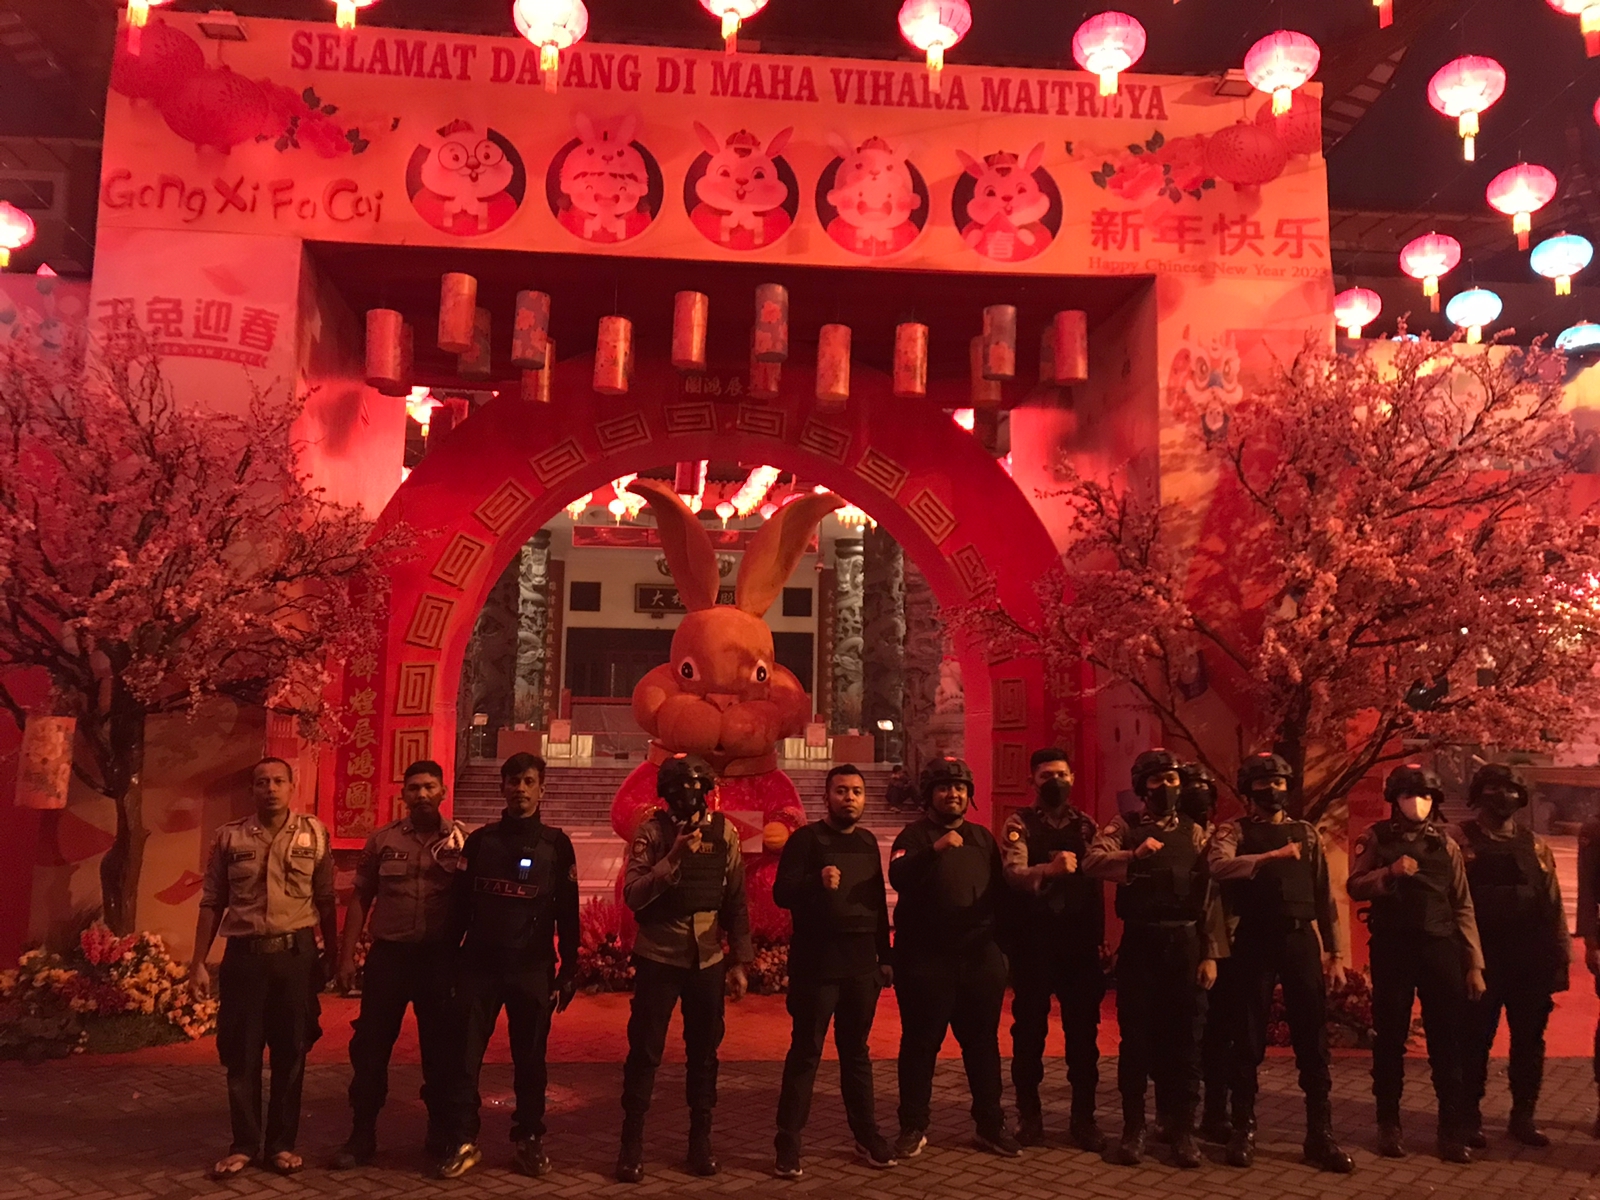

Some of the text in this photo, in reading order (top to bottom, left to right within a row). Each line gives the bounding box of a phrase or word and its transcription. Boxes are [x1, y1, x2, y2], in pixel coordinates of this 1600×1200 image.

[290, 29, 477, 81] SELAMAT
[489, 46, 642, 92] DAANG
[655, 56, 698, 95] DI
[709, 60, 819, 102] MAHA
[830, 67, 970, 111] VIHARA
[101, 168, 384, 223] Gong Xi Fa Cai
[1090, 207, 1326, 260] 新年快乐
[1088, 256, 1139, 274] Happy
[1145, 259, 1205, 274] Chinese
[1213, 262, 1248, 276] New
[1252, 263, 1287, 278] Year
